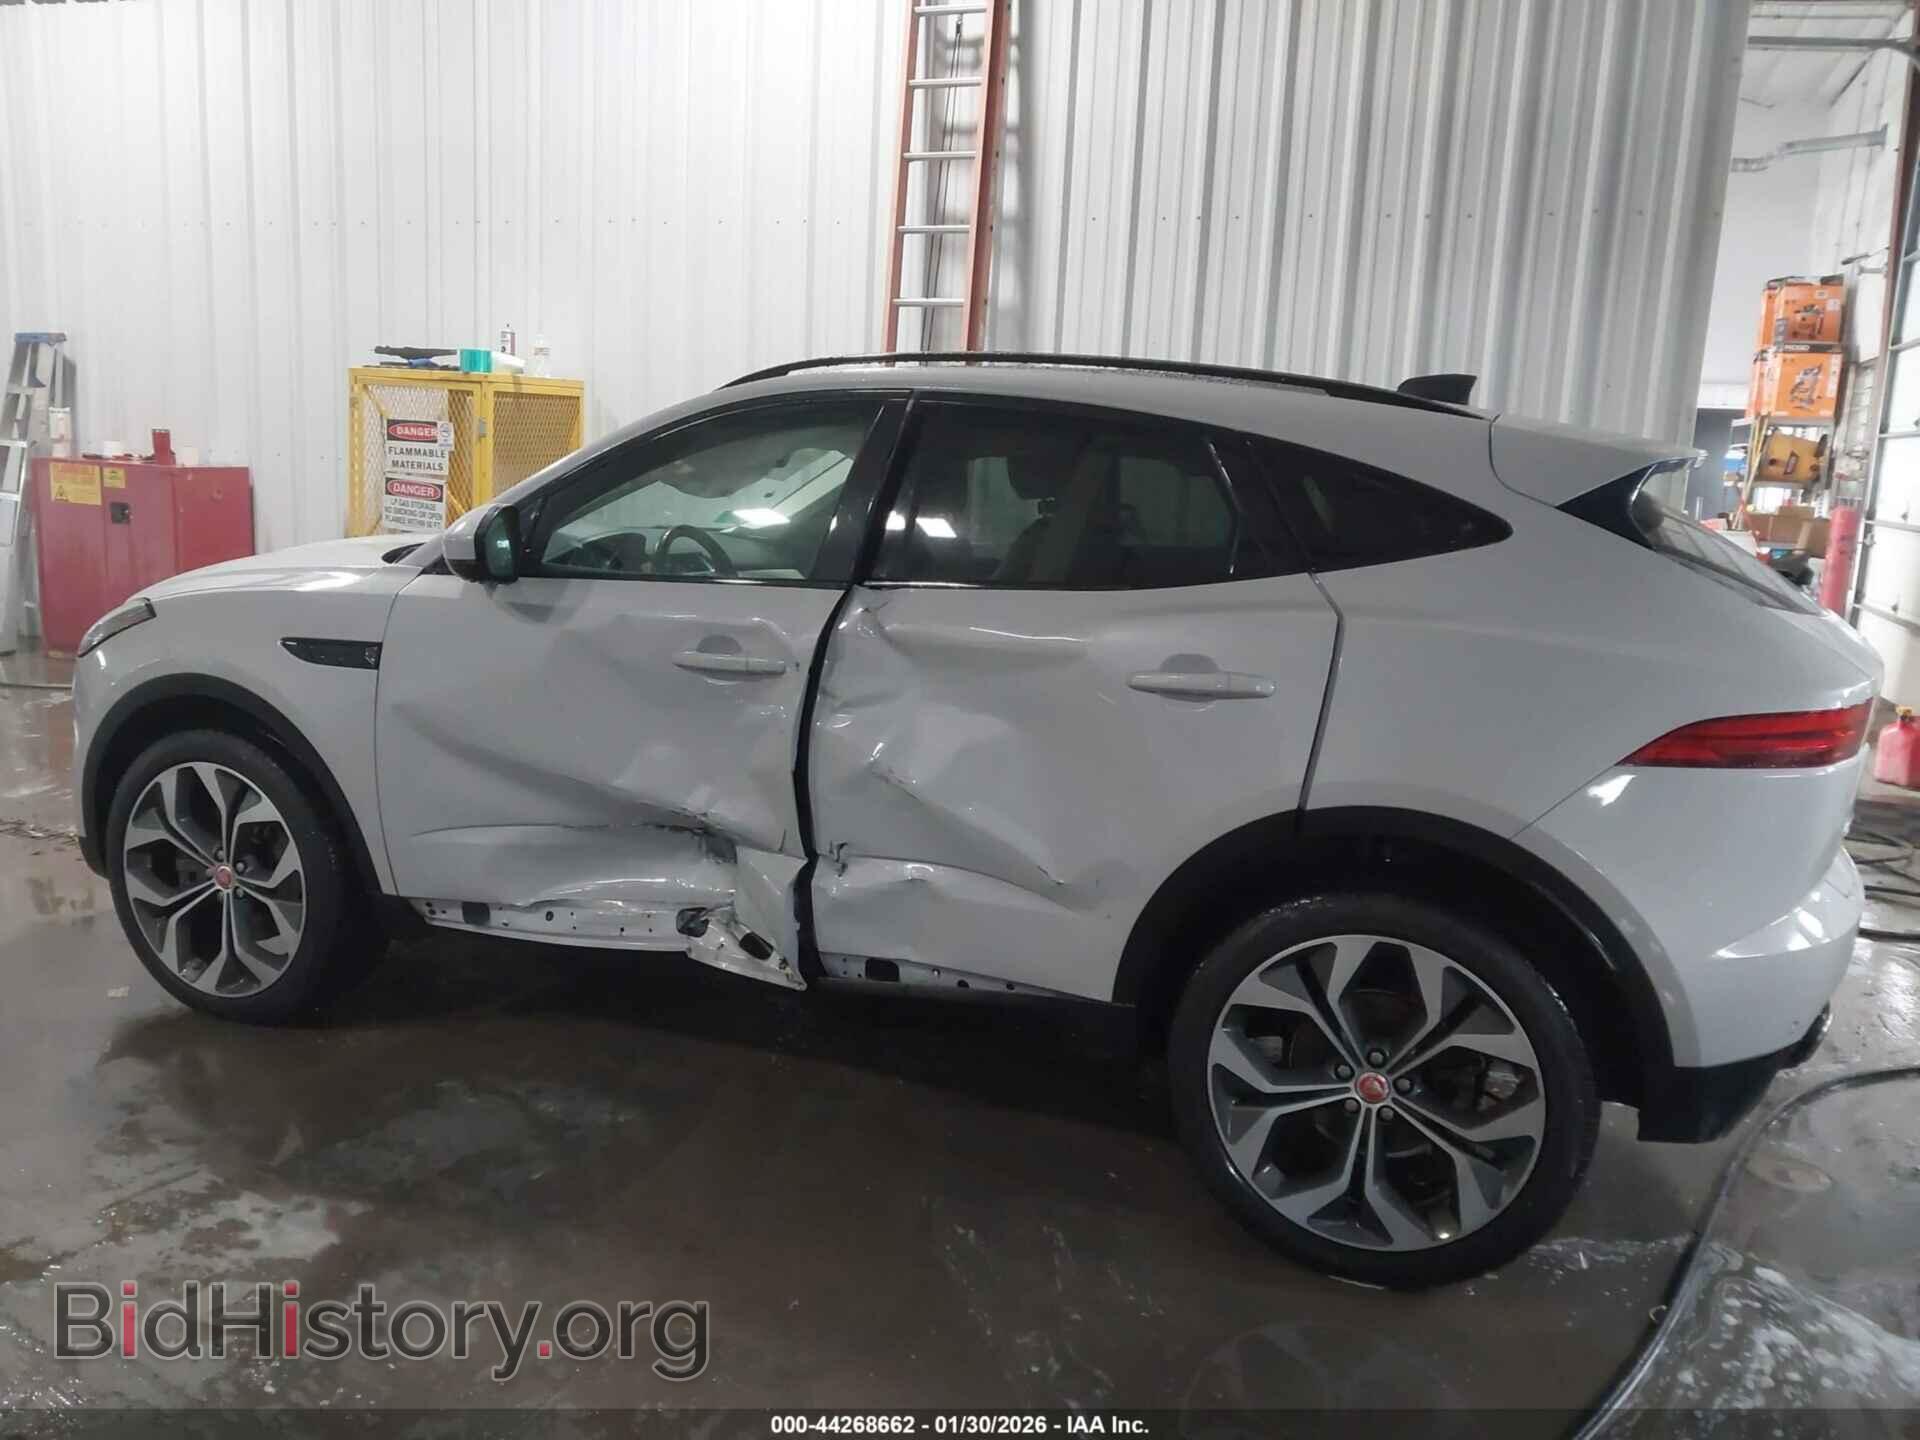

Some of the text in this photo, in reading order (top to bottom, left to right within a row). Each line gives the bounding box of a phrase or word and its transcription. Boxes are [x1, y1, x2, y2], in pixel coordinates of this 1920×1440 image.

[388, 447, 446, 459] FLAMMABLE
[392, 460, 444, 471] MATERIALS
[393, 482, 434, 497] DANGER
